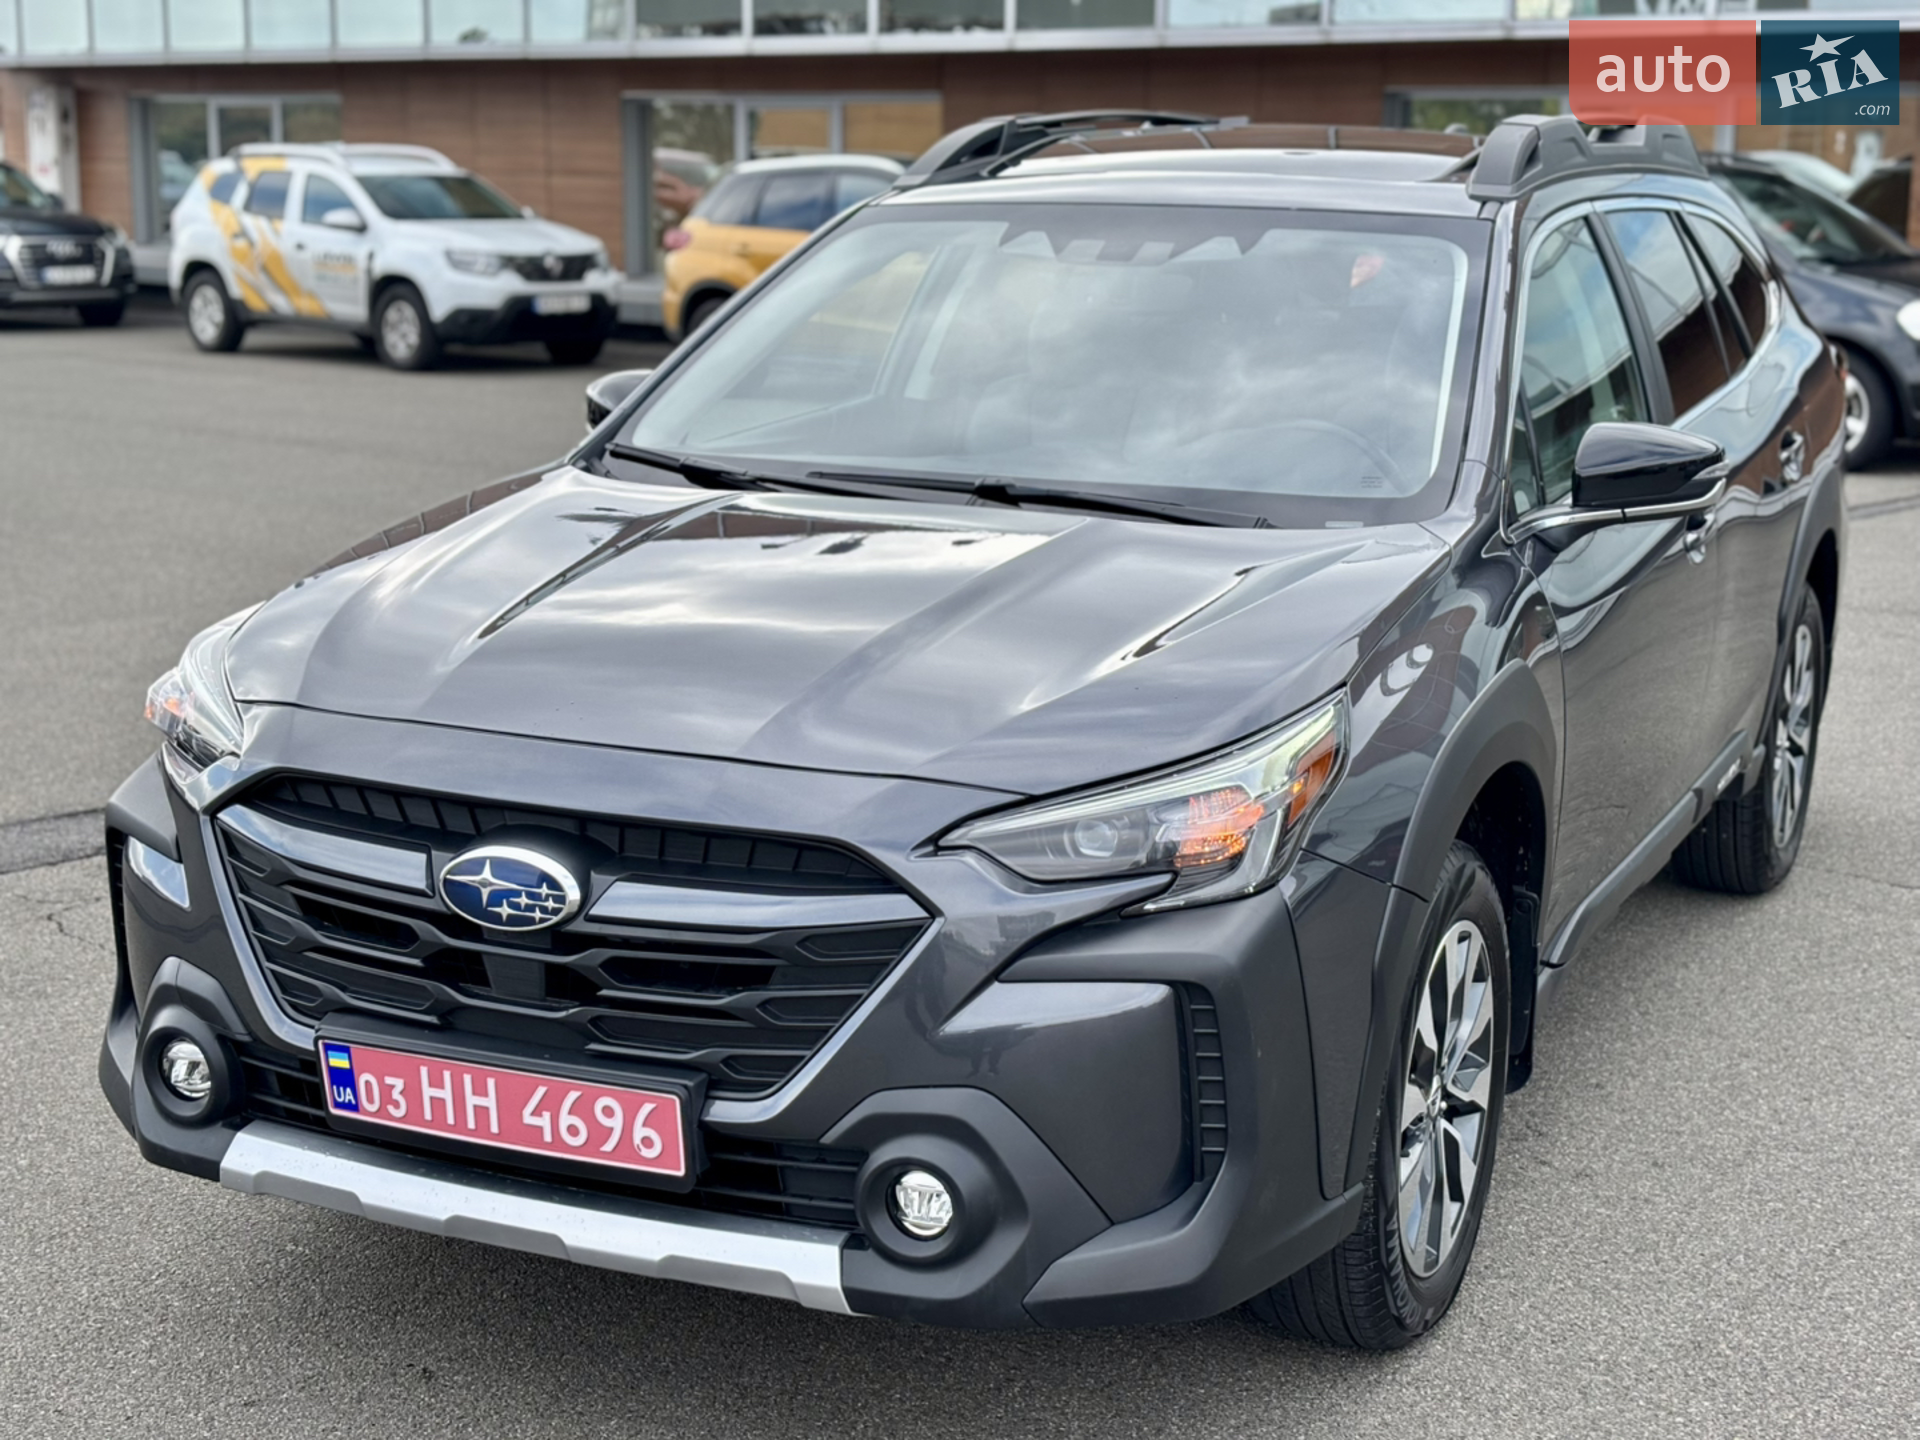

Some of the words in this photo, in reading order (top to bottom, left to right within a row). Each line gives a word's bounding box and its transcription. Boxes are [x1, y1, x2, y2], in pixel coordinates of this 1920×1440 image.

[332, 1084, 357, 1106] UA
[358, 1072, 408, 1119] 03
[419, 1065, 500, 1135] HH
[521, 1085, 663, 1160] 4696
